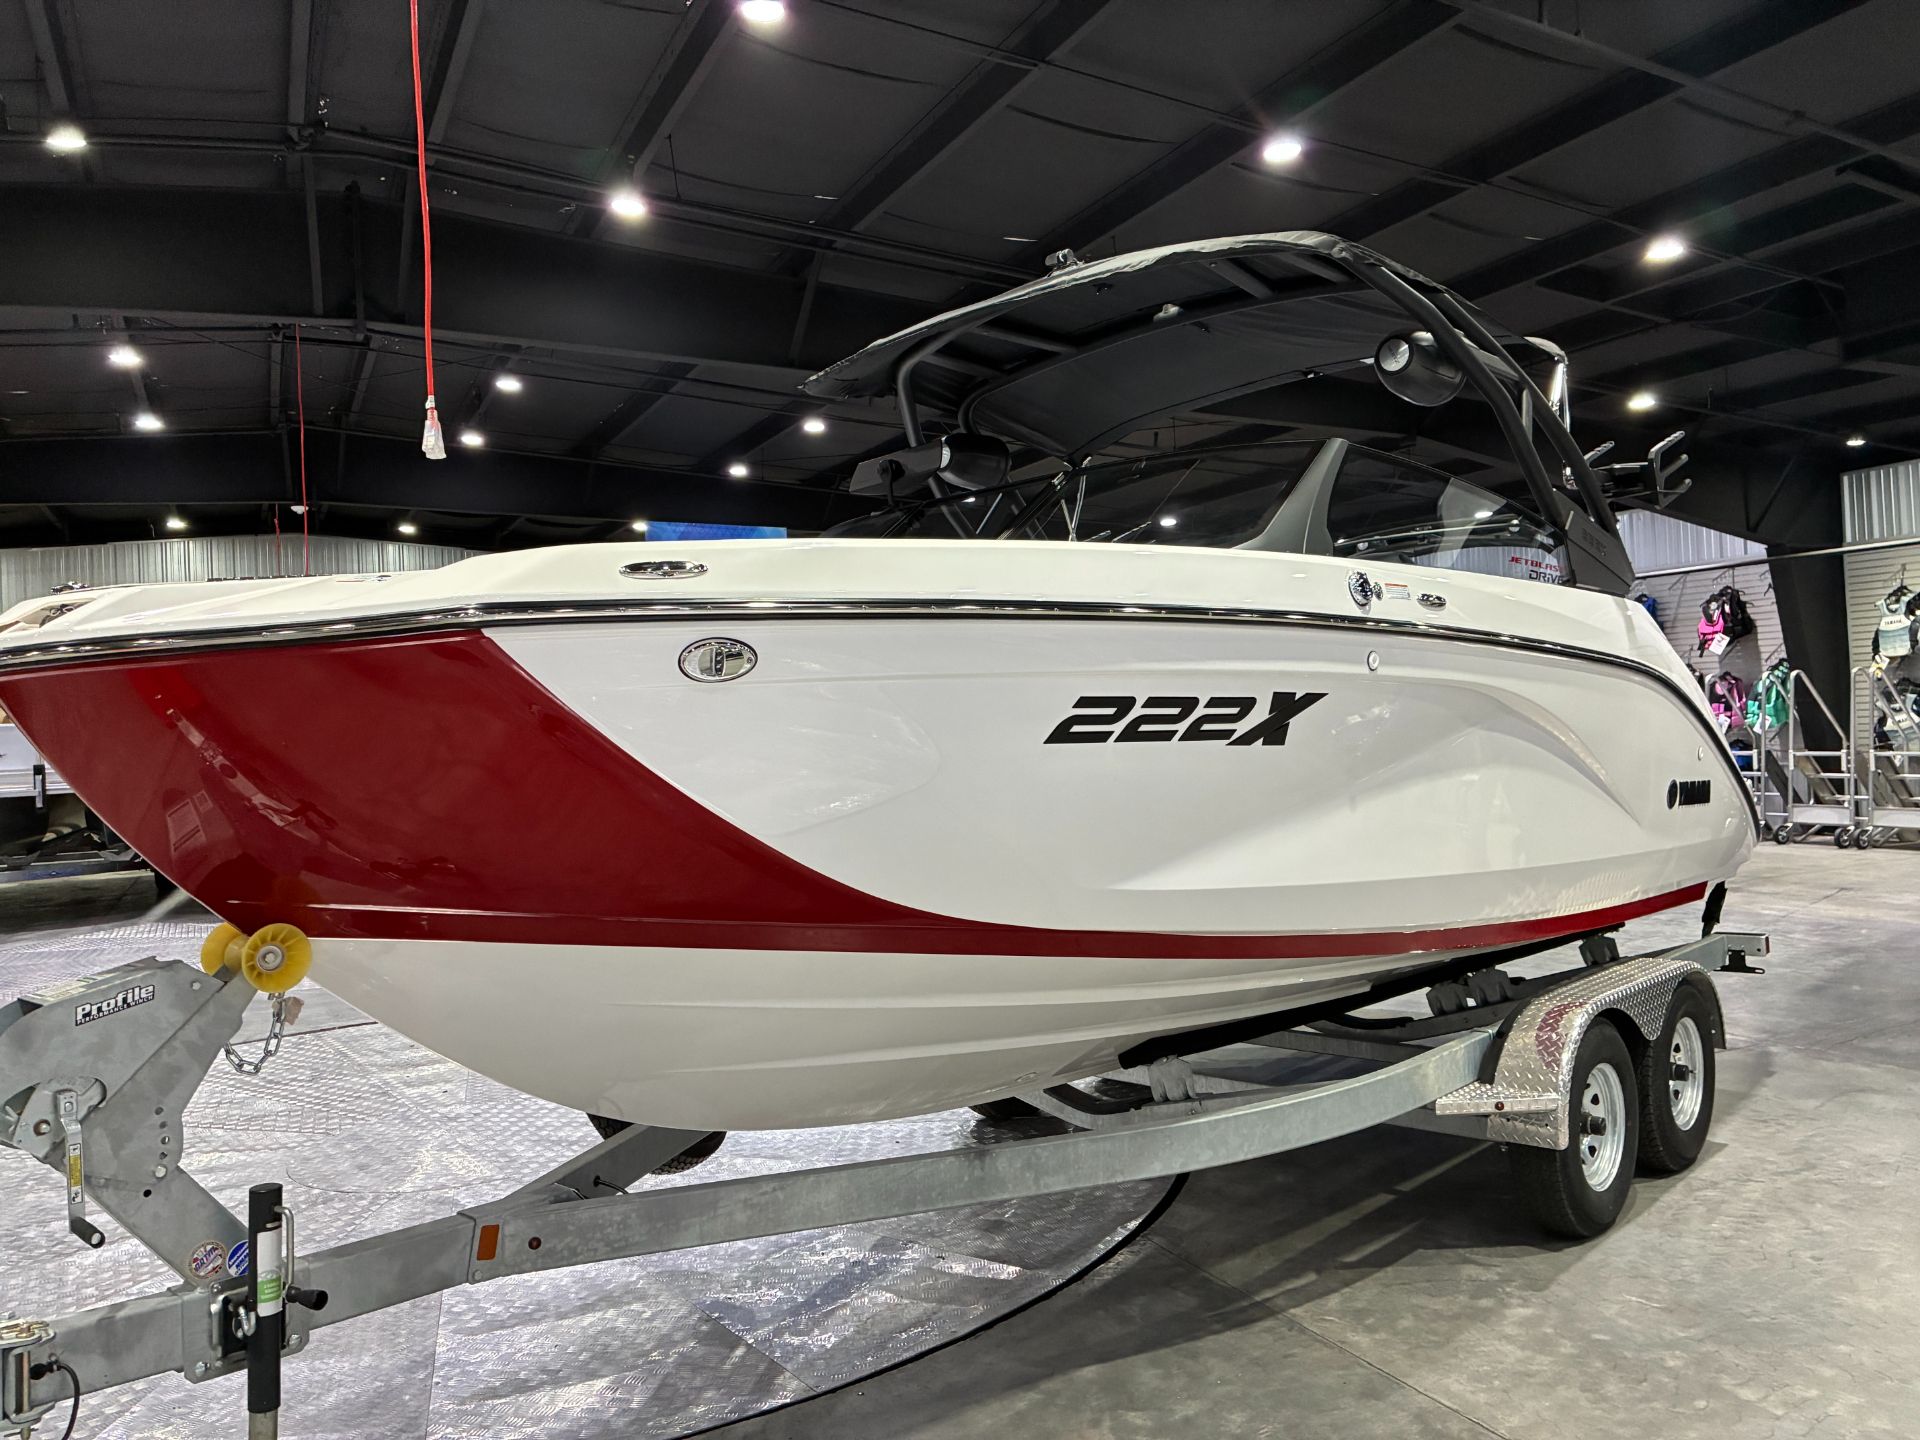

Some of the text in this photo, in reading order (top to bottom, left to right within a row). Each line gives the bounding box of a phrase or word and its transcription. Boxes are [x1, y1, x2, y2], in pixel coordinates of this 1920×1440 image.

[1043, 691, 1329, 746] 222X
[76, 985, 155, 1020] Profile
[77, 995, 153, 1025] PERFORMANCE WINCH
